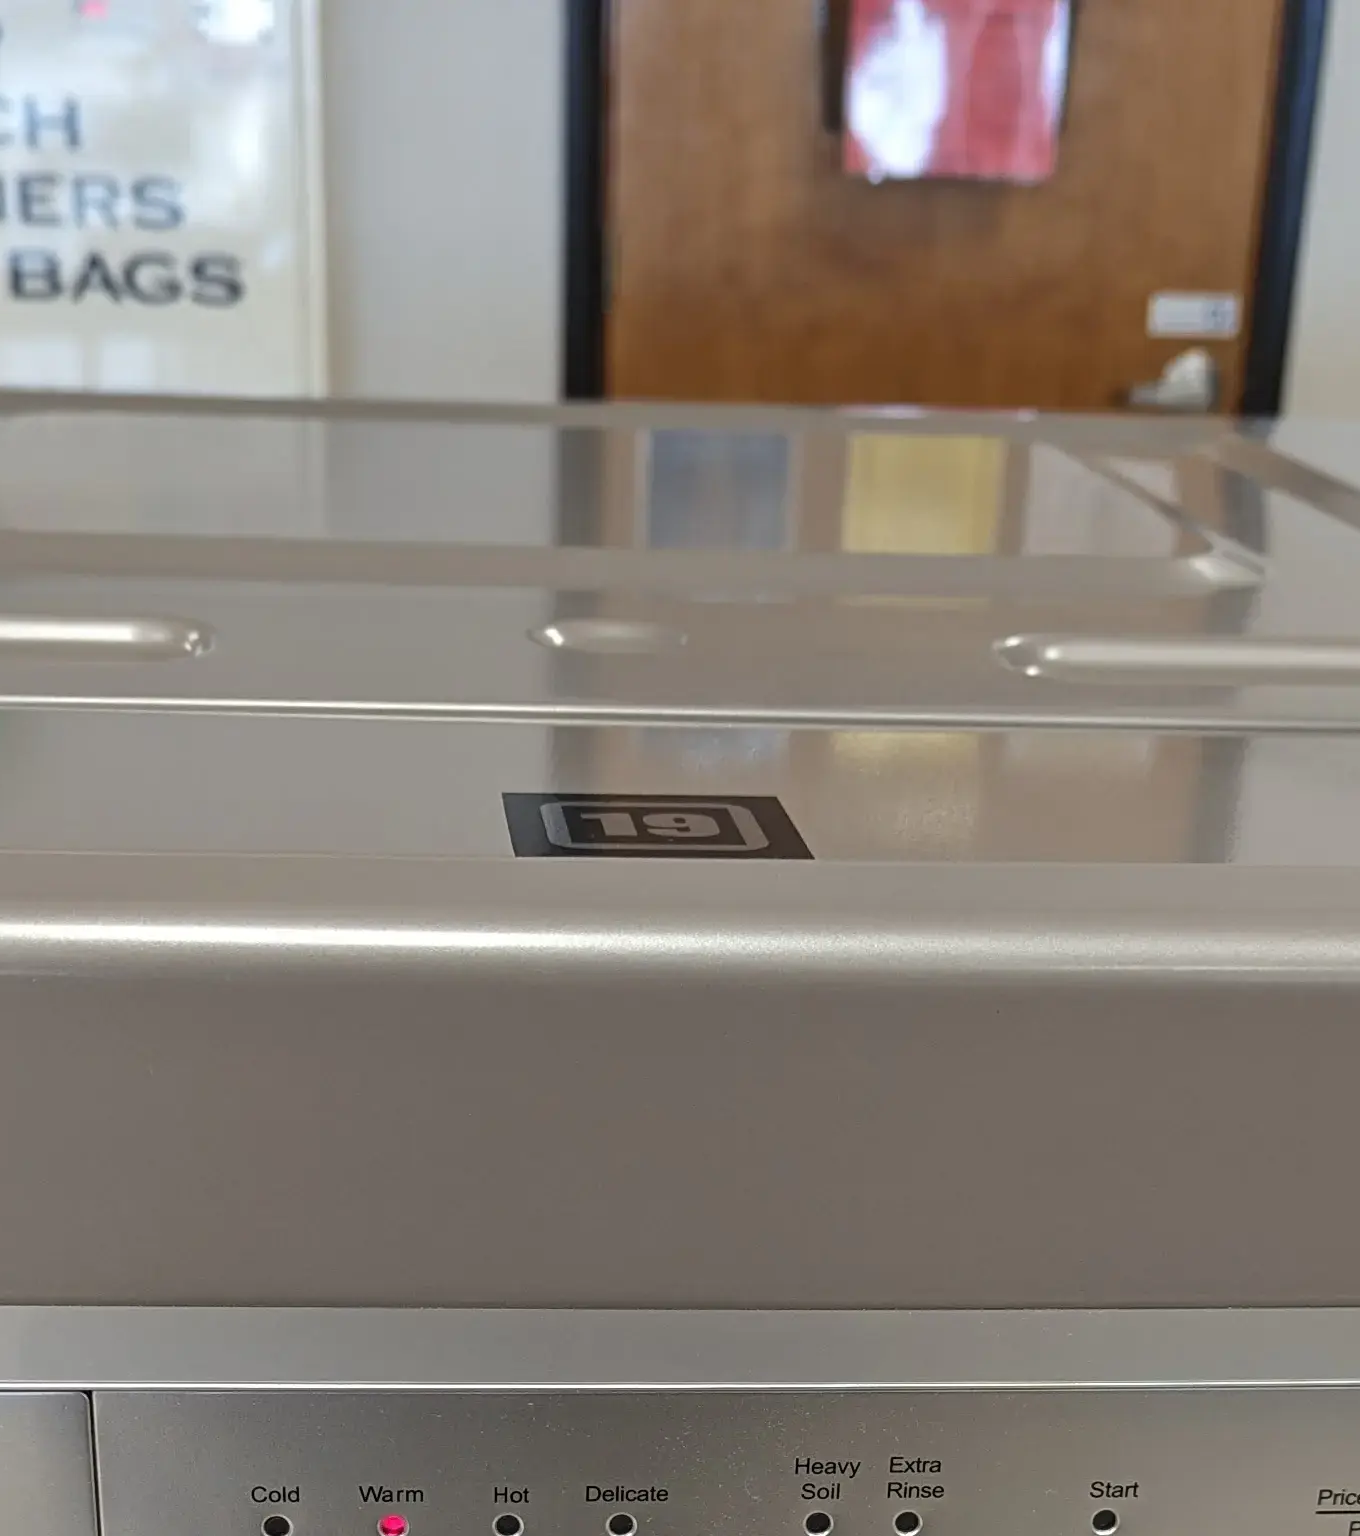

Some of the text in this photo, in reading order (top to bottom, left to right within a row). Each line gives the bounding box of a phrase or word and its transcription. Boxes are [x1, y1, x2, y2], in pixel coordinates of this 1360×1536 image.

[8, 252, 244, 308] BAGS
[580, 811, 721, 837] 19
[794, 1457, 861, 1478] Heavy
[889, 1456, 942, 1474] Extra
[251, 1486, 300, 1503] Cold
[358, 1485, 424, 1503] Warm
[493, 1486, 530, 1504] Hot
[585, 1485, 669, 1503] Delicate
[801, 1483, 841, 1500] Soil
[887, 1482, 945, 1499] Rinse
[1089, 1481, 1139, 1499] Start
